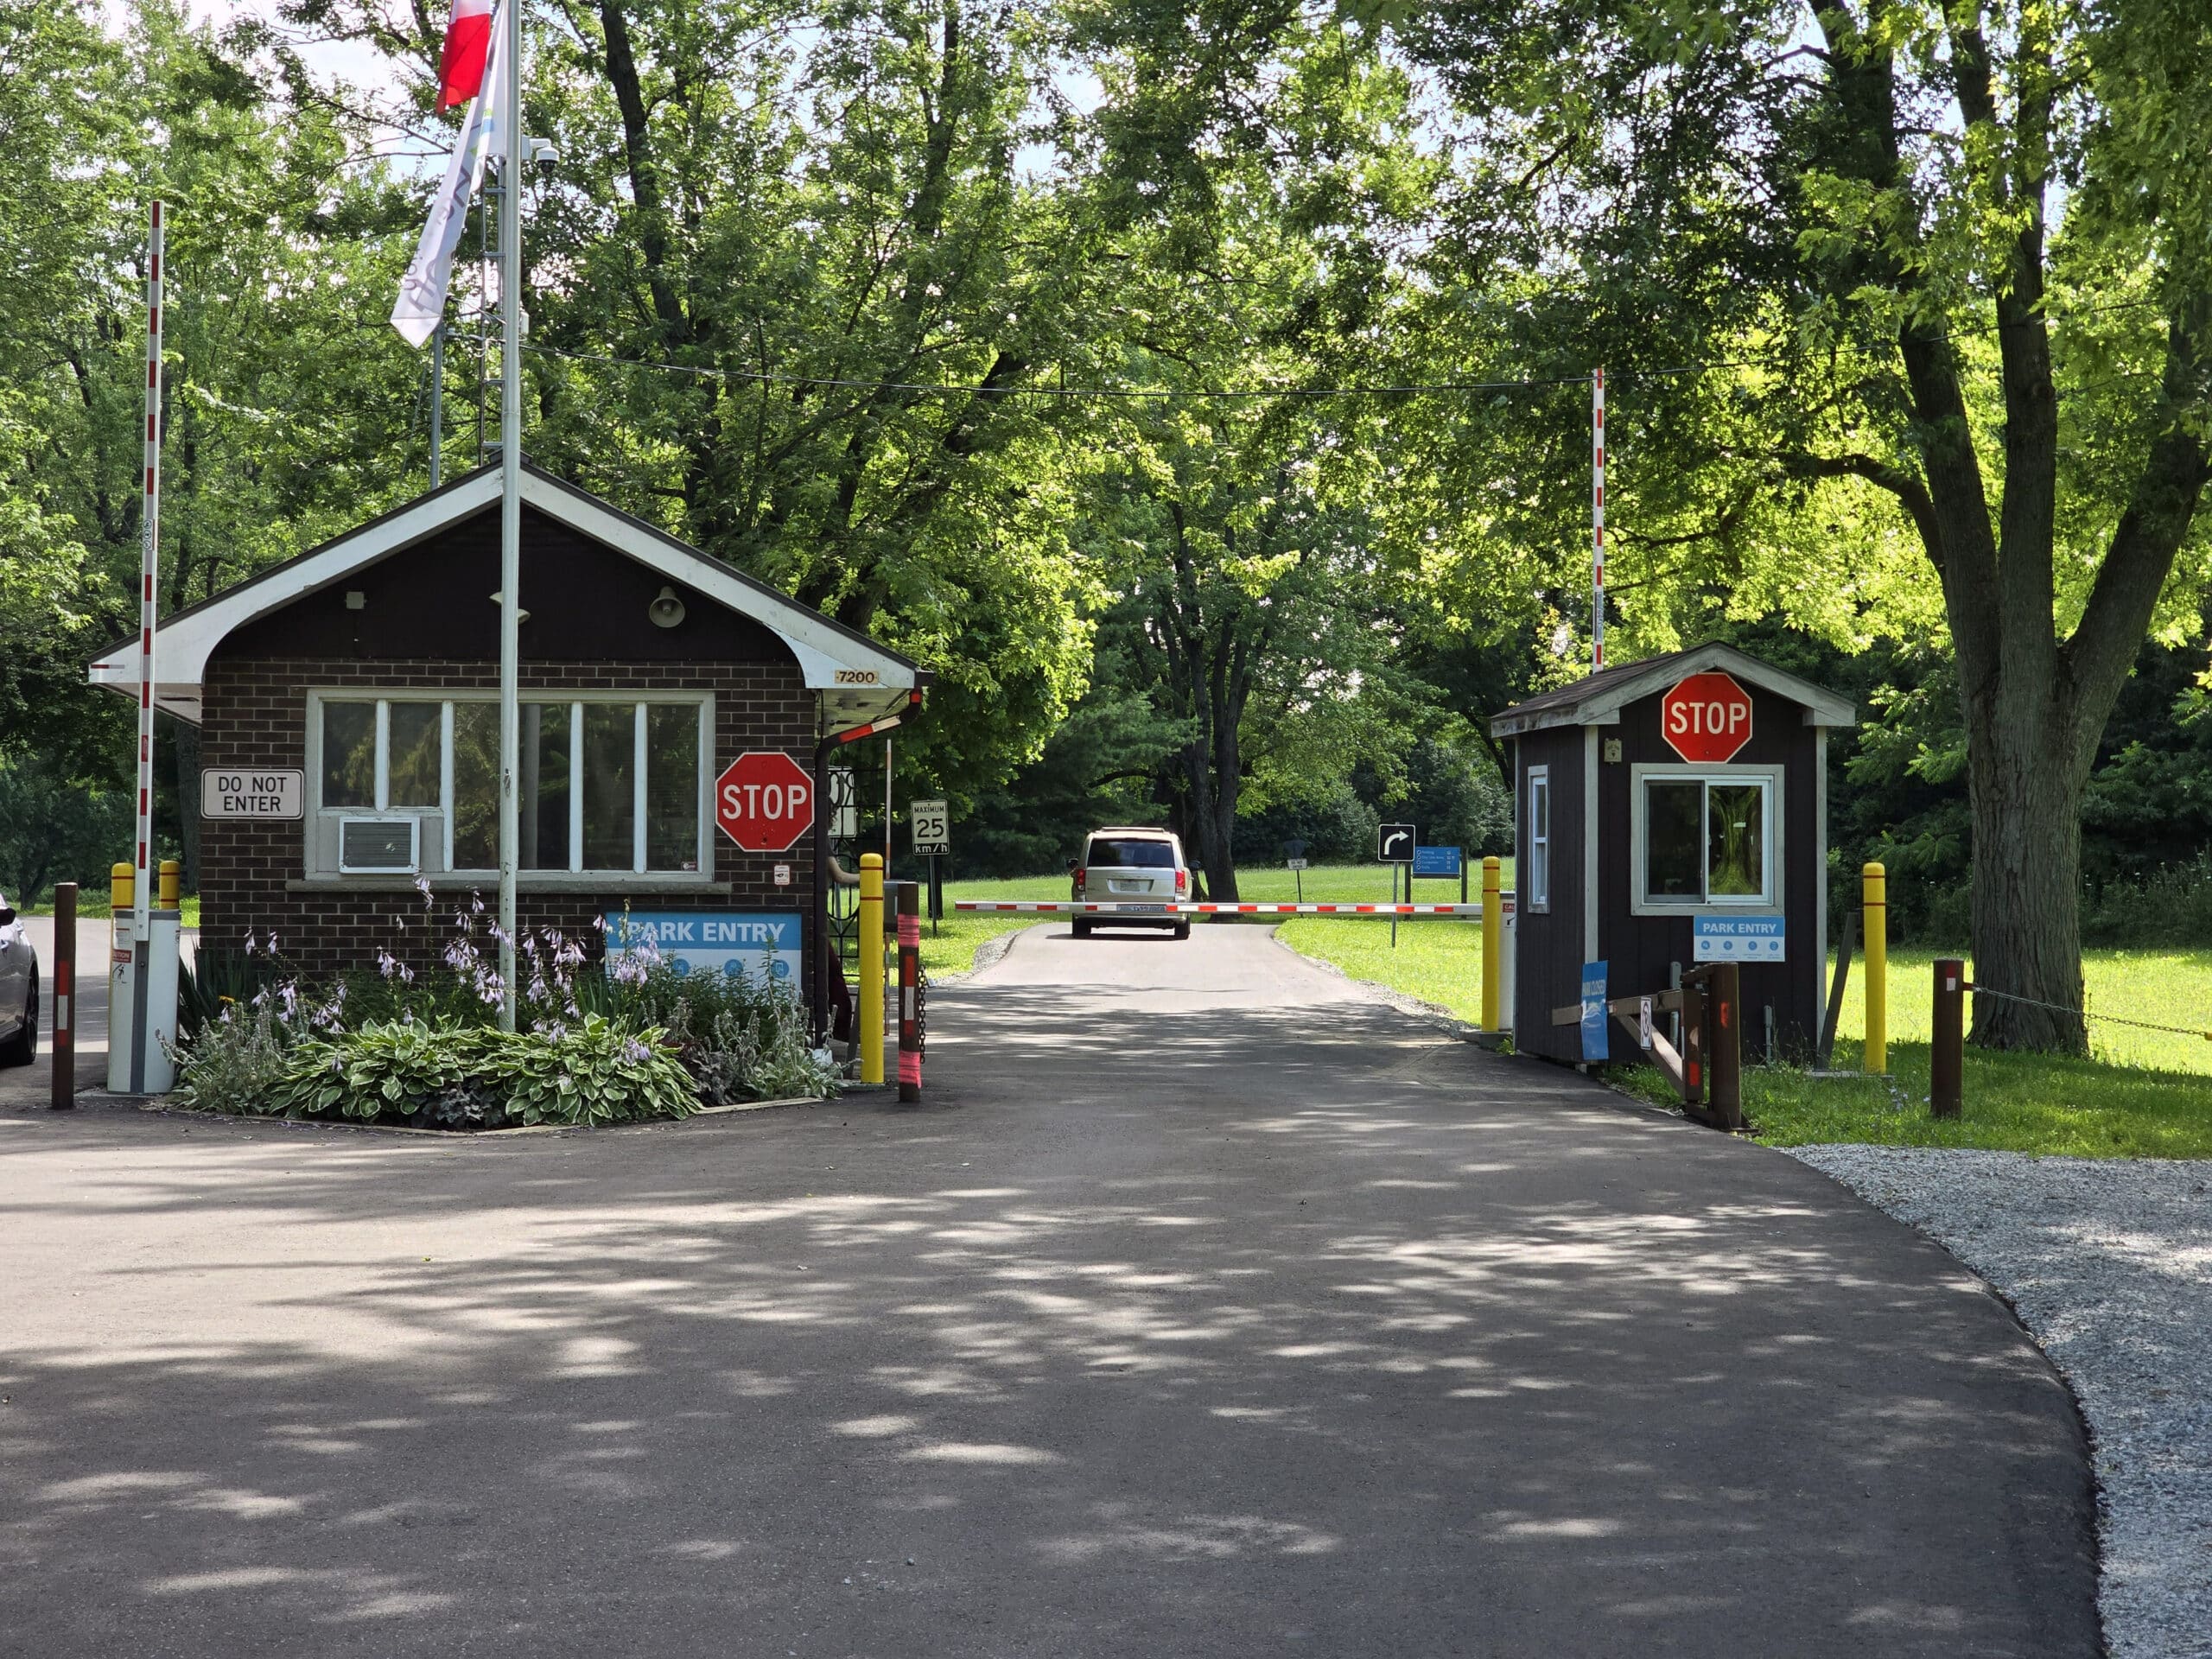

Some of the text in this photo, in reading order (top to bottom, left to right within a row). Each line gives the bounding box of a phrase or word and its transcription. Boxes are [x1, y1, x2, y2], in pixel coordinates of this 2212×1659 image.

[839, 671, 874, 683] 7200
[1669, 702, 1746, 734] STOP
[219, 776, 287, 792] DO NOT
[224, 796, 281, 811] ENTER
[722, 785, 807, 819] STOP
[917, 817, 944, 837] 25
[915, 843, 947, 854] km/h
[626, 921, 785, 942] PARK ENTRY
[1703, 923, 1777, 934] PARK ENTRY
